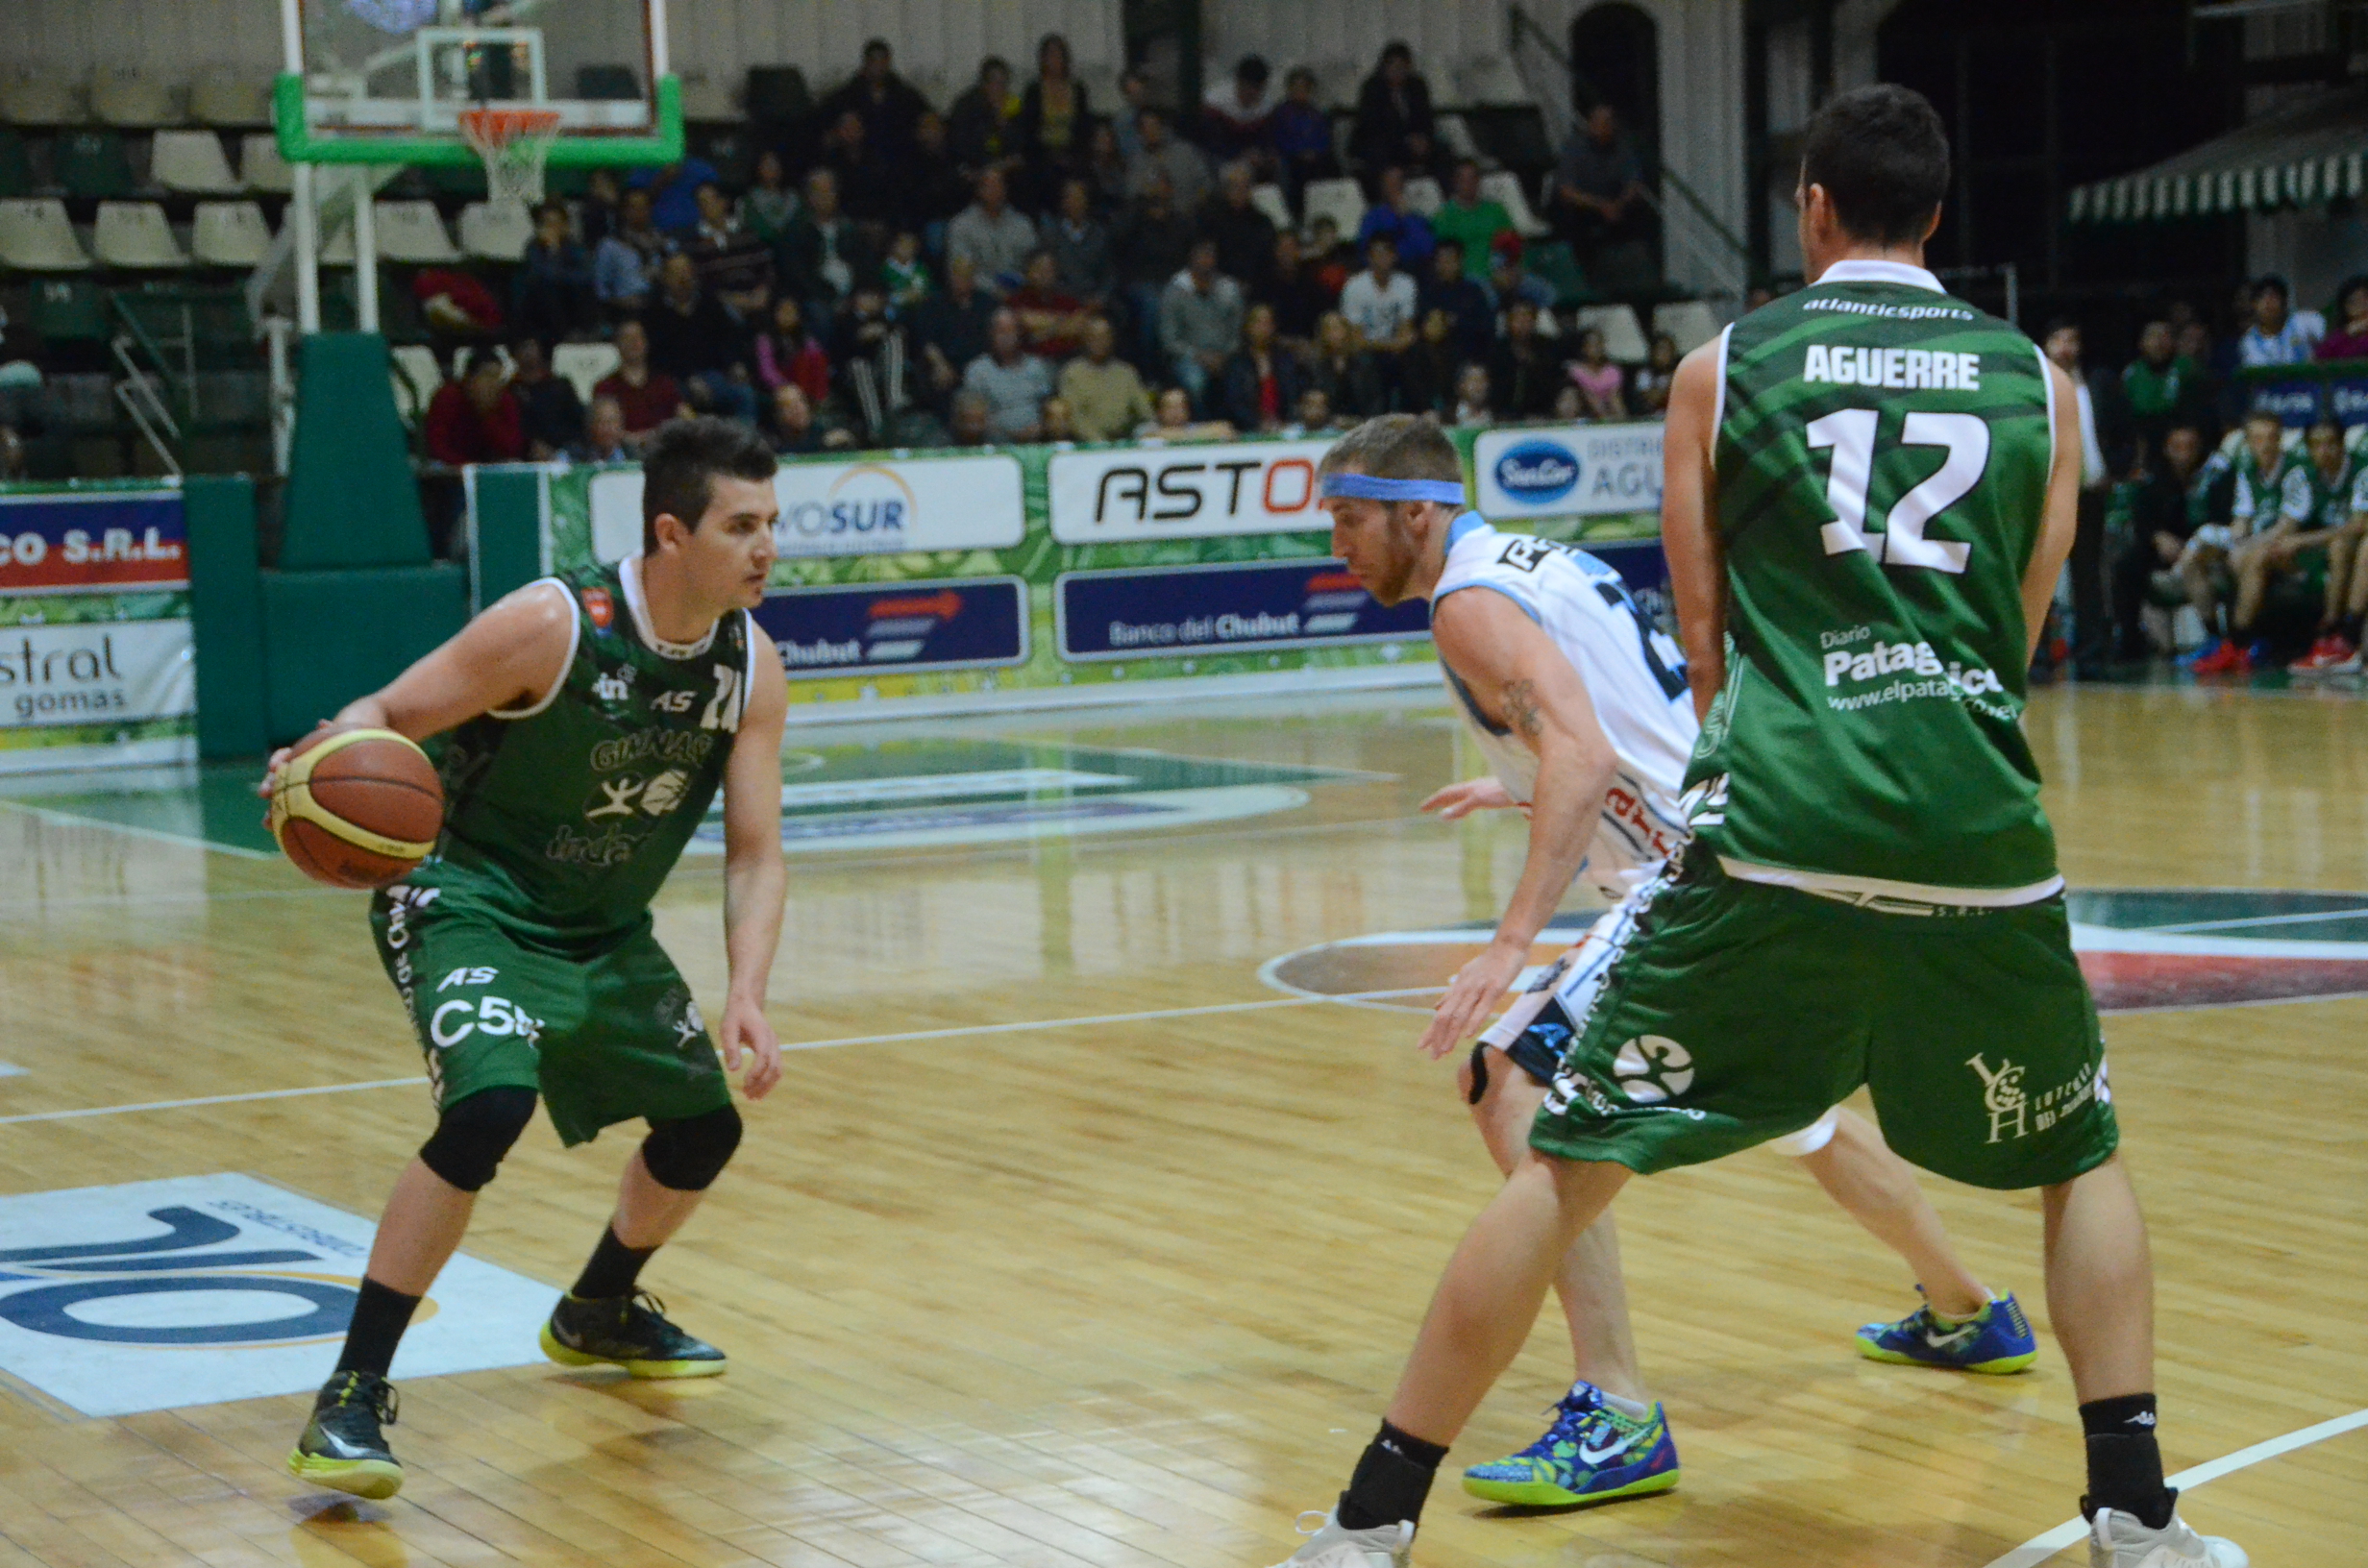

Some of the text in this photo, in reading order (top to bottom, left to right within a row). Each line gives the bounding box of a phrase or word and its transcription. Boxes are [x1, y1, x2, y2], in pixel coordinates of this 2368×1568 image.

[1802, 297, 1974, 321] atlanticsports
[1803, 344, 1981, 391] AGUERRE
[1095, 457, 1323, 523] ASTO
[1807, 408, 1990, 574] 12
[62, 527, 182, 564] S.R.L.
[1108, 610, 1299, 648] Banco del Chubut
[1819, 625, 1873, 650] Diario
[14, 689, 127, 721] gomas
